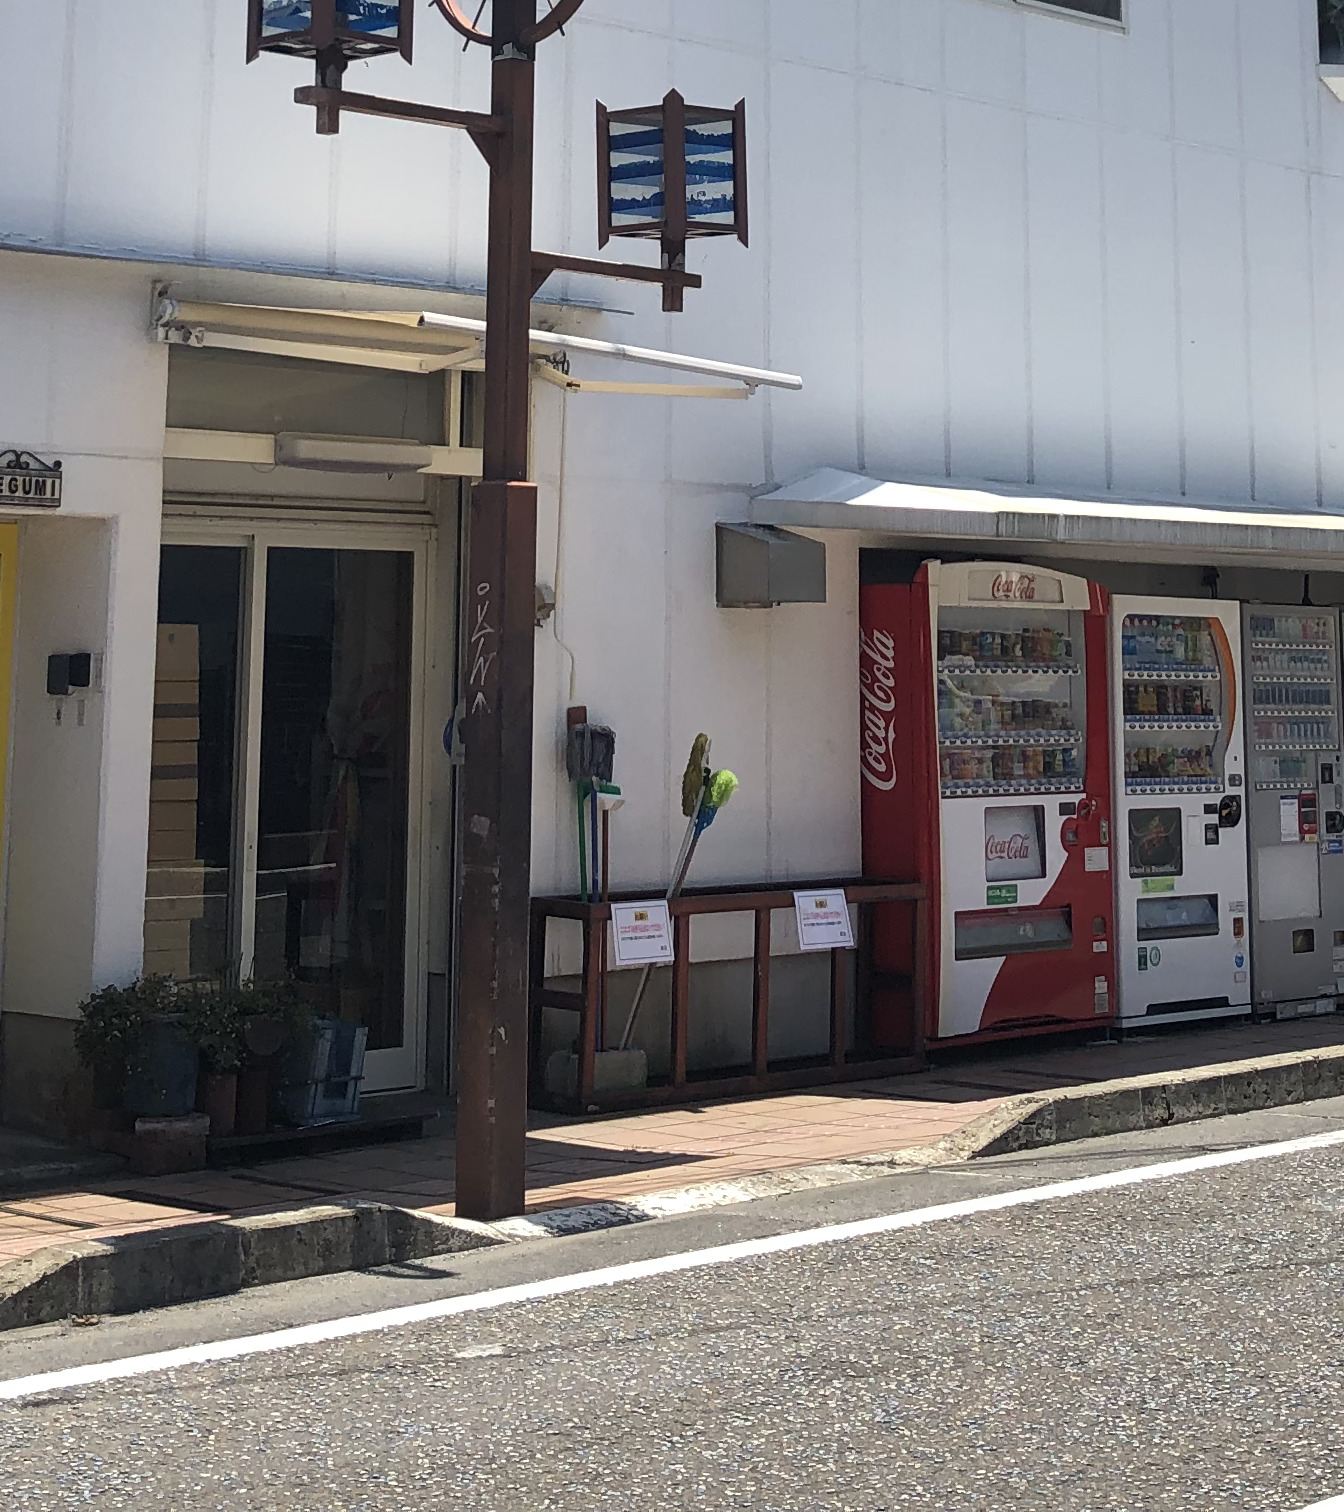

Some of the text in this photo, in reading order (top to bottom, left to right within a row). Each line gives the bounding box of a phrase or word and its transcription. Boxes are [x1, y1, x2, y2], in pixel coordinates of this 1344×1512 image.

[992, 572, 1037, 600] Coca-Cola
[860, 627, 897, 791] Coca-Cola
[985, 833, 1030, 861] Coca-Cola
